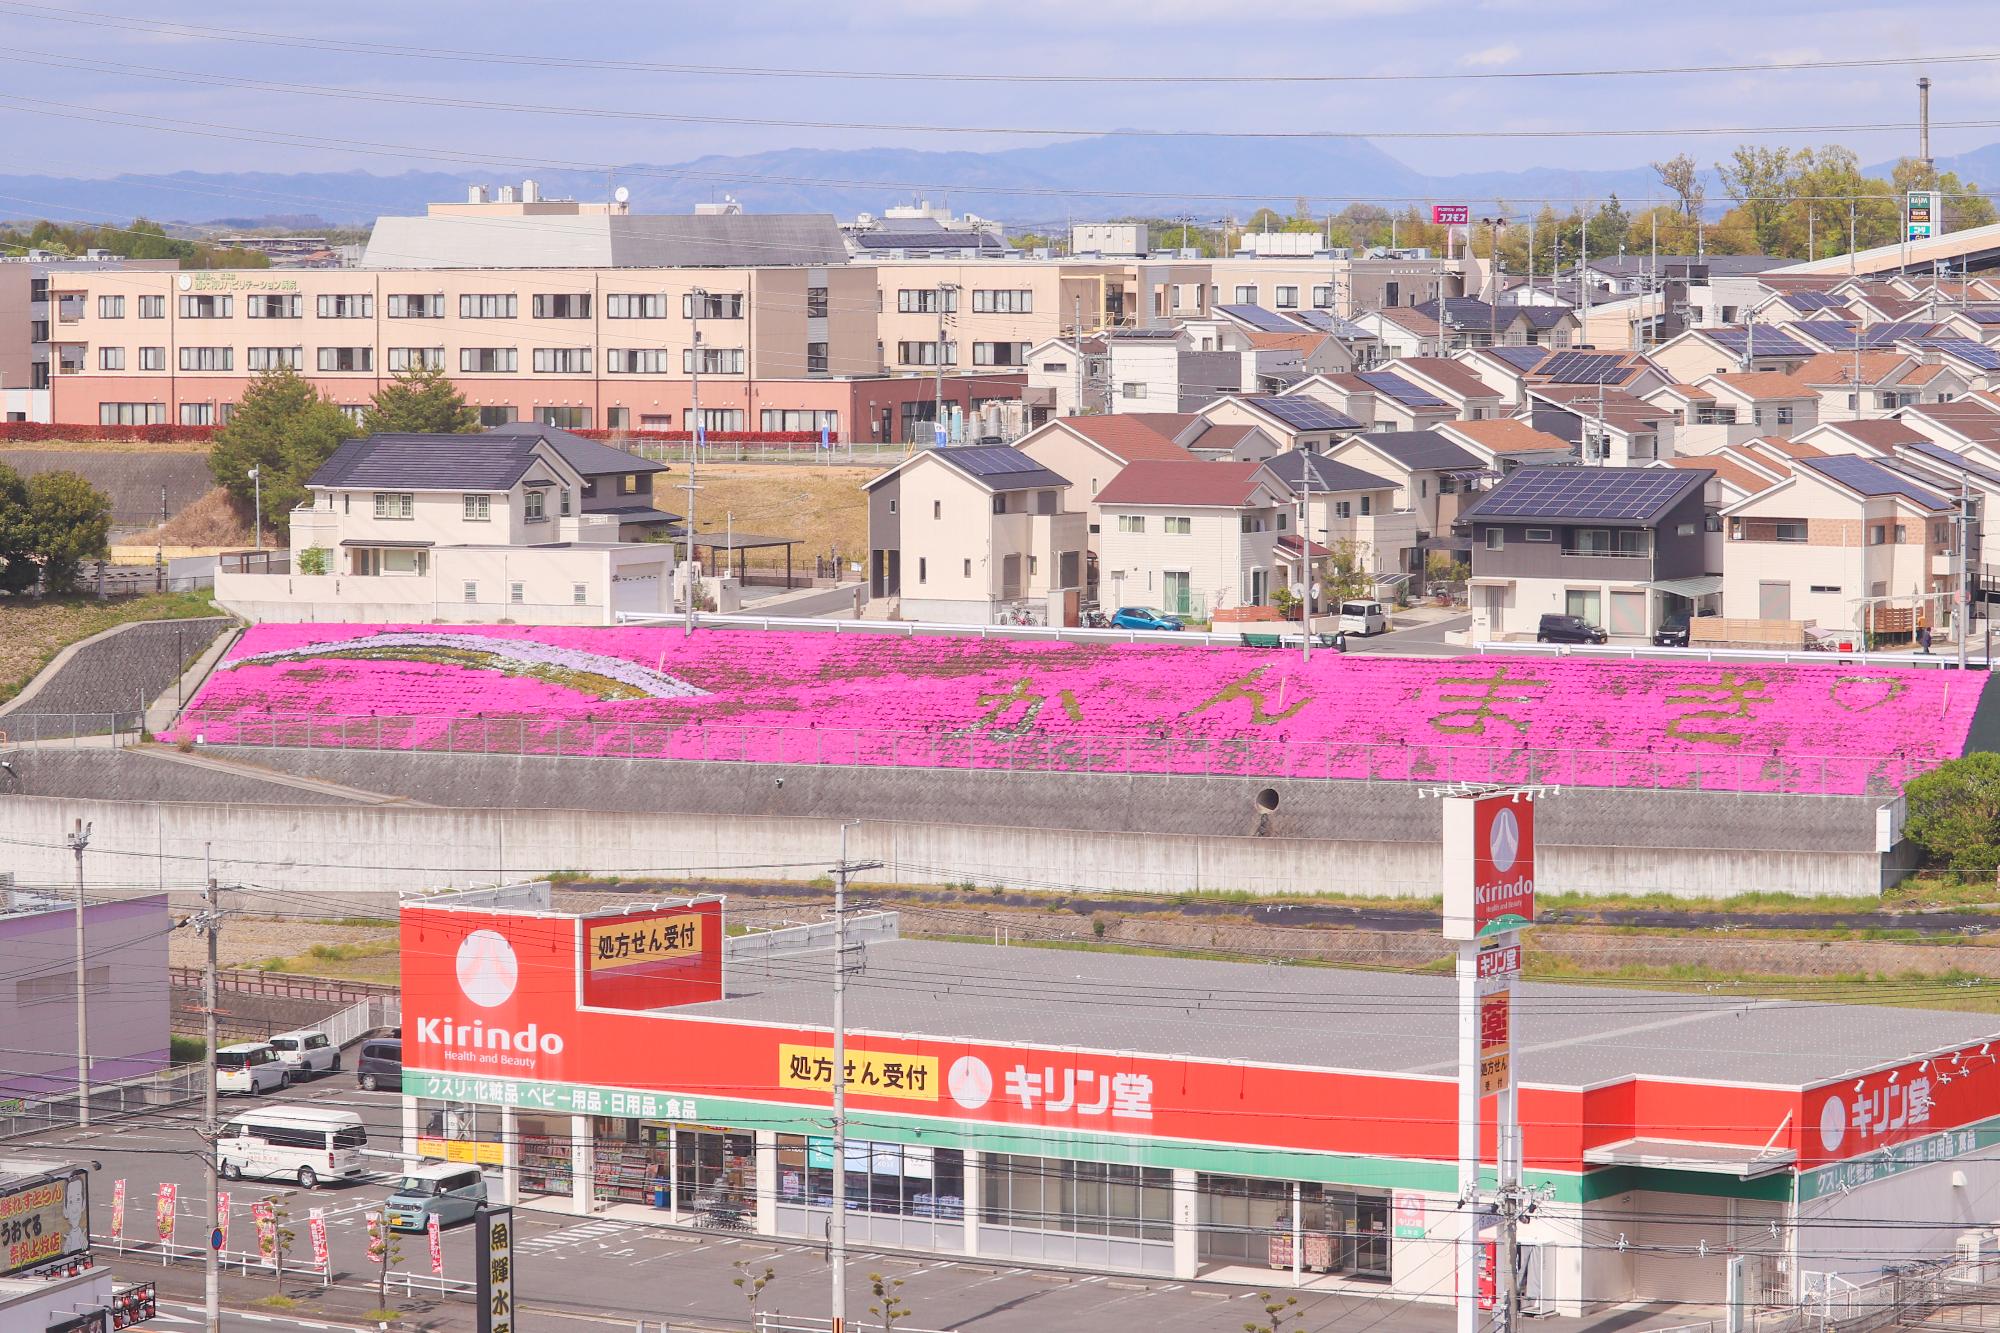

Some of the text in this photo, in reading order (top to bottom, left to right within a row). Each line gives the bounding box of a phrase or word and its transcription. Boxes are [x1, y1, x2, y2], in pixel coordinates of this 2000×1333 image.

[1439, 213, 1466, 222] コスモス
[1475, 875, 1533, 905] Kirindo
[599, 922, 694, 960] 処方せん受付
[1481, 949, 1516, 974] キリン堂
[417, 1017, 563, 1054] Kirindo
[1481, 1000, 1507, 1049] 薬
[444, 1051, 536, 1070] Health and Beauty
[790, 1054, 927, 1091] 処方せん受付
[1481, 1058, 1508, 1077] 処方せん
[1005, 1064, 1153, 1119] キリン堂
[1852, 1076, 1930, 1138] キリン堂
[1, 1214, 42, 1246] うおてる
